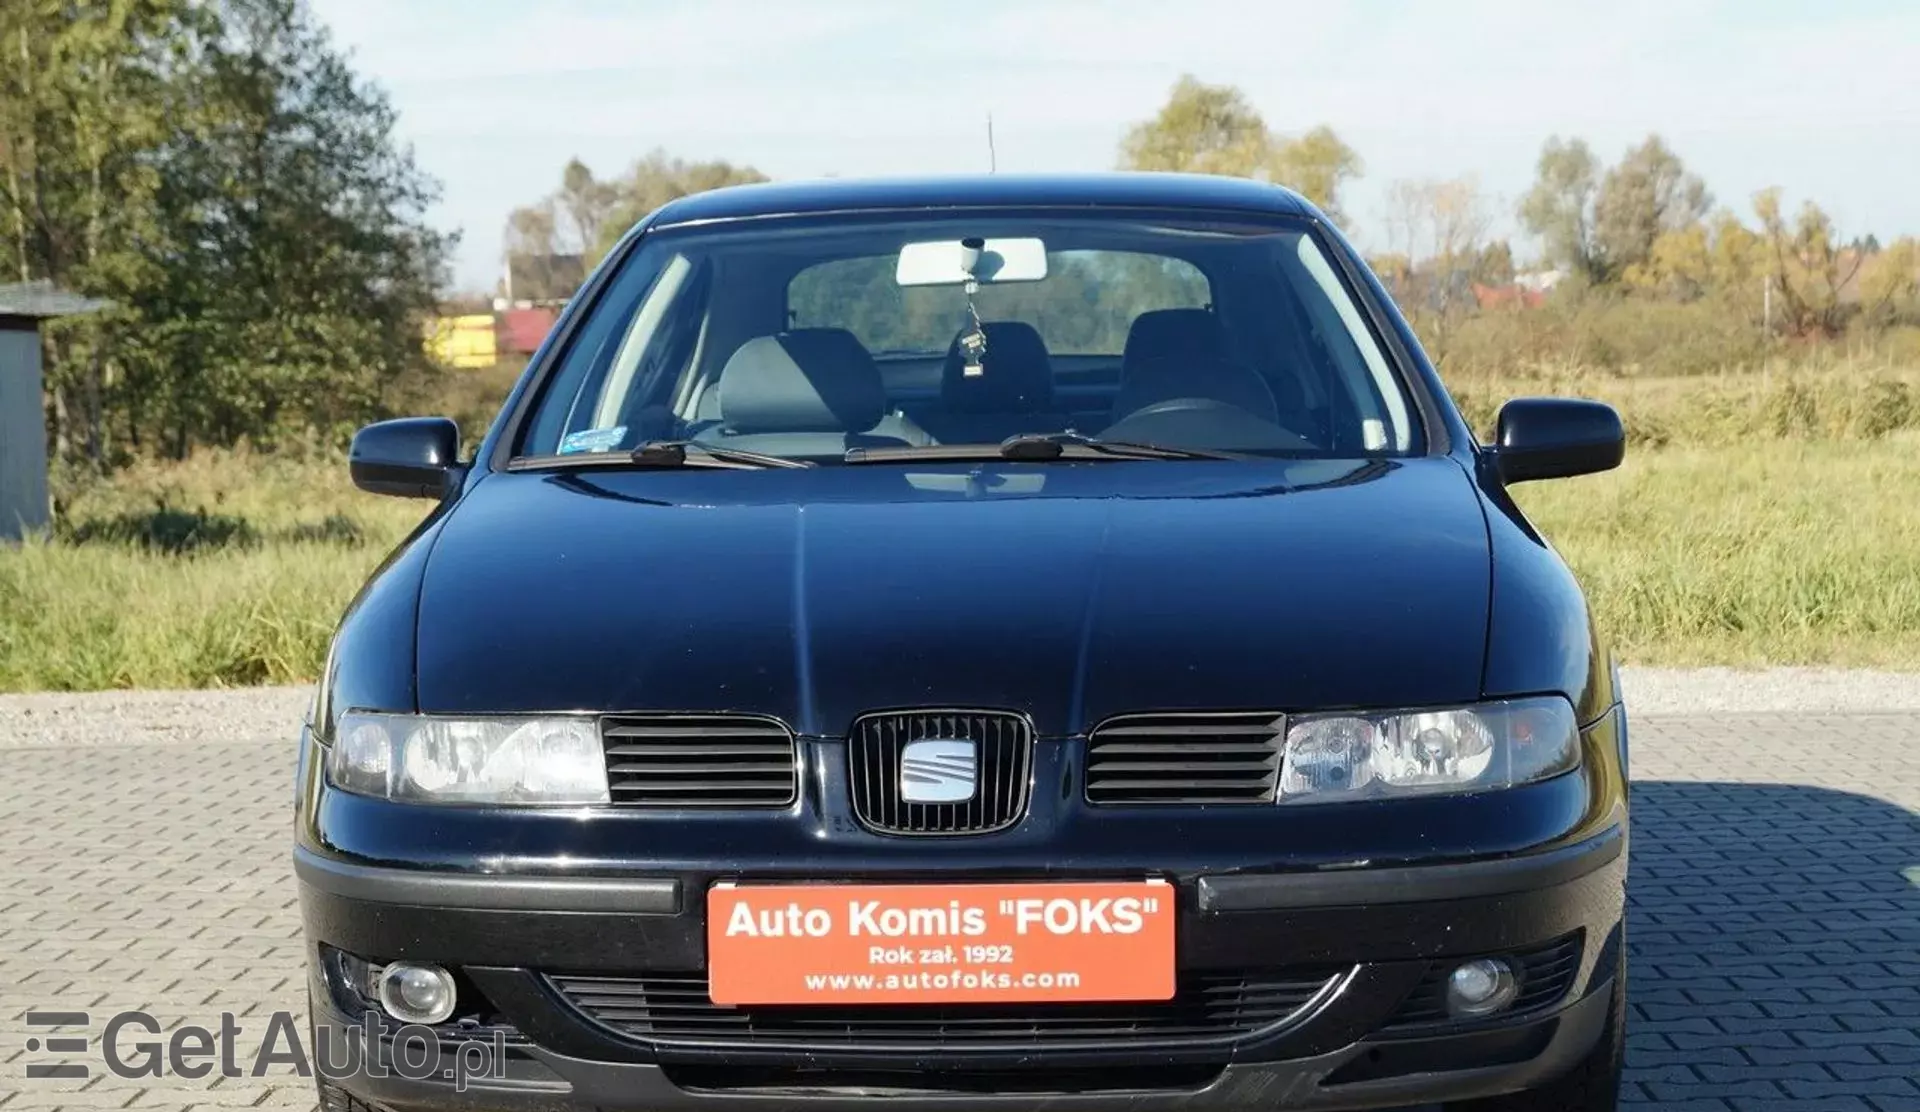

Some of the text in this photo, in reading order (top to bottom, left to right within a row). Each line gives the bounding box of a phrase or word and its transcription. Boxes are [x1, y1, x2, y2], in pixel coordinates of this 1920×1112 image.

[725, 896, 1159, 938] Auto Komis "FOKS"
[868, 944, 1014, 965] Rok zał. 1992
[805, 969, 1080, 991] www.autofoks.com
